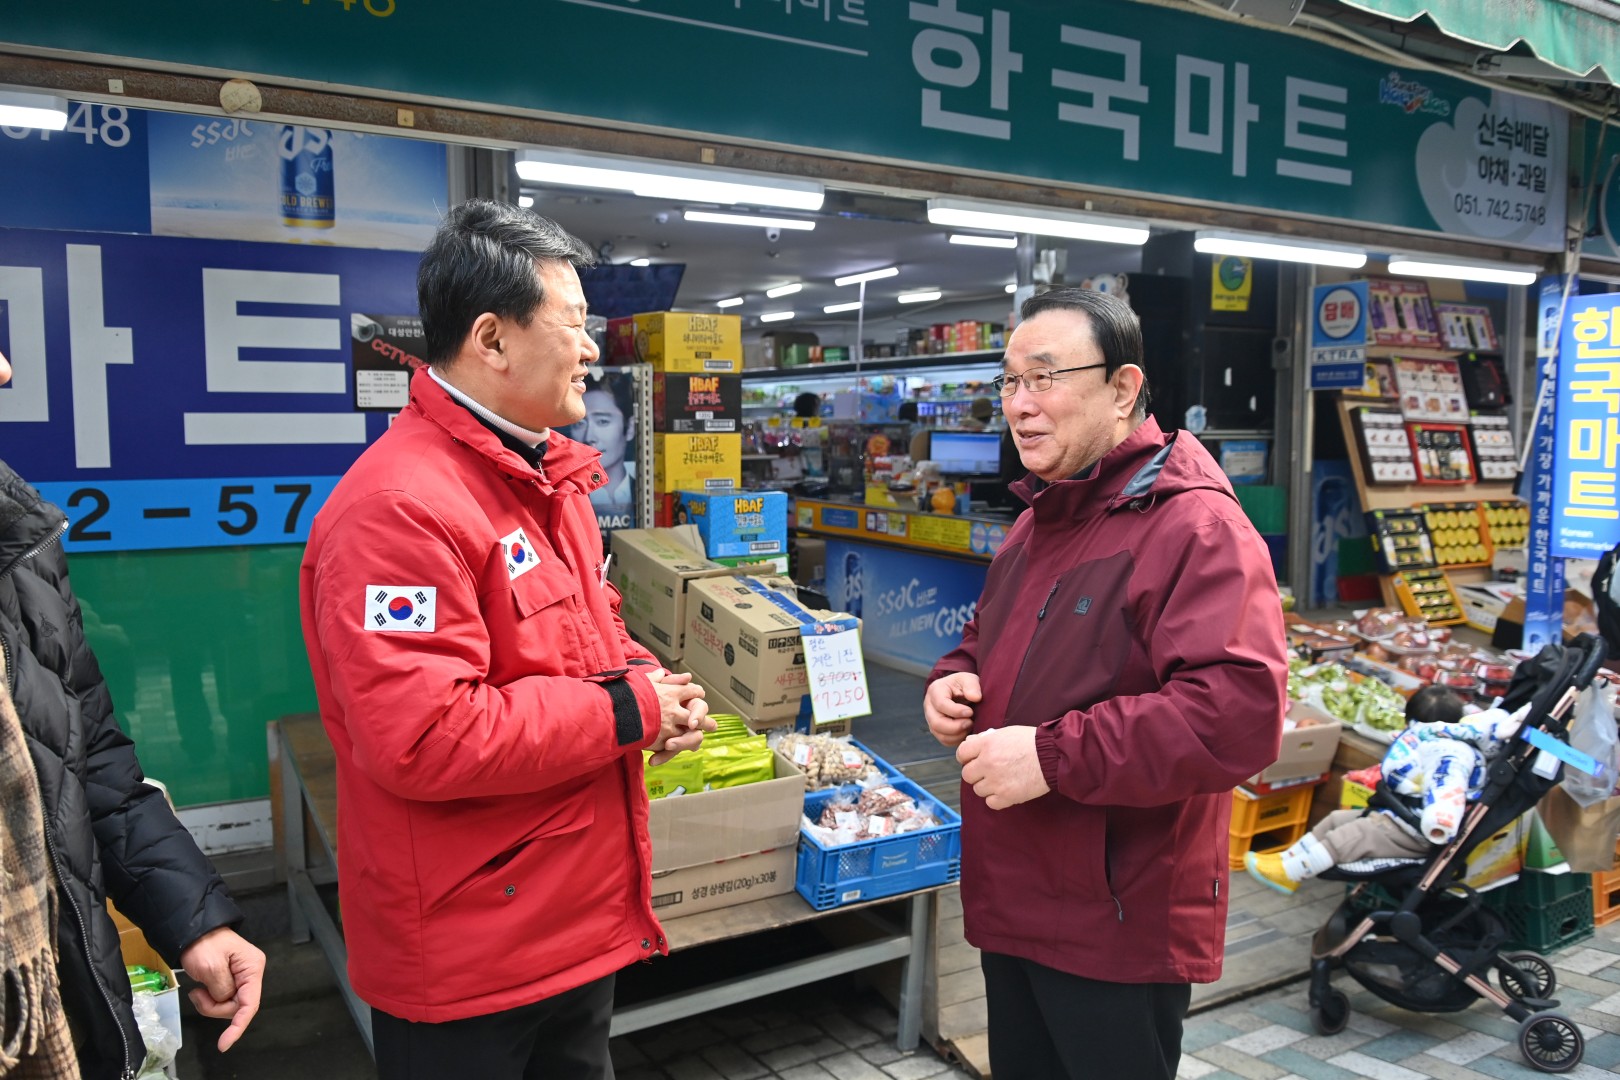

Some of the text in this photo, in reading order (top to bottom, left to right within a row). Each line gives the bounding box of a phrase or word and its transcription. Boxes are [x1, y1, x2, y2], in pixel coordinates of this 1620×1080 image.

[909, 0, 1353, 186] 한국마트
[1478, 113, 1549, 158] 신속배달
[1317, 350, 1360, 361] KTRA
[688, 376, 720, 393] HBAF
[1563, 306, 1620, 519] 한국마트
[688, 436, 719, 452] HBAF
[734, 497, 764, 514] HBAF
